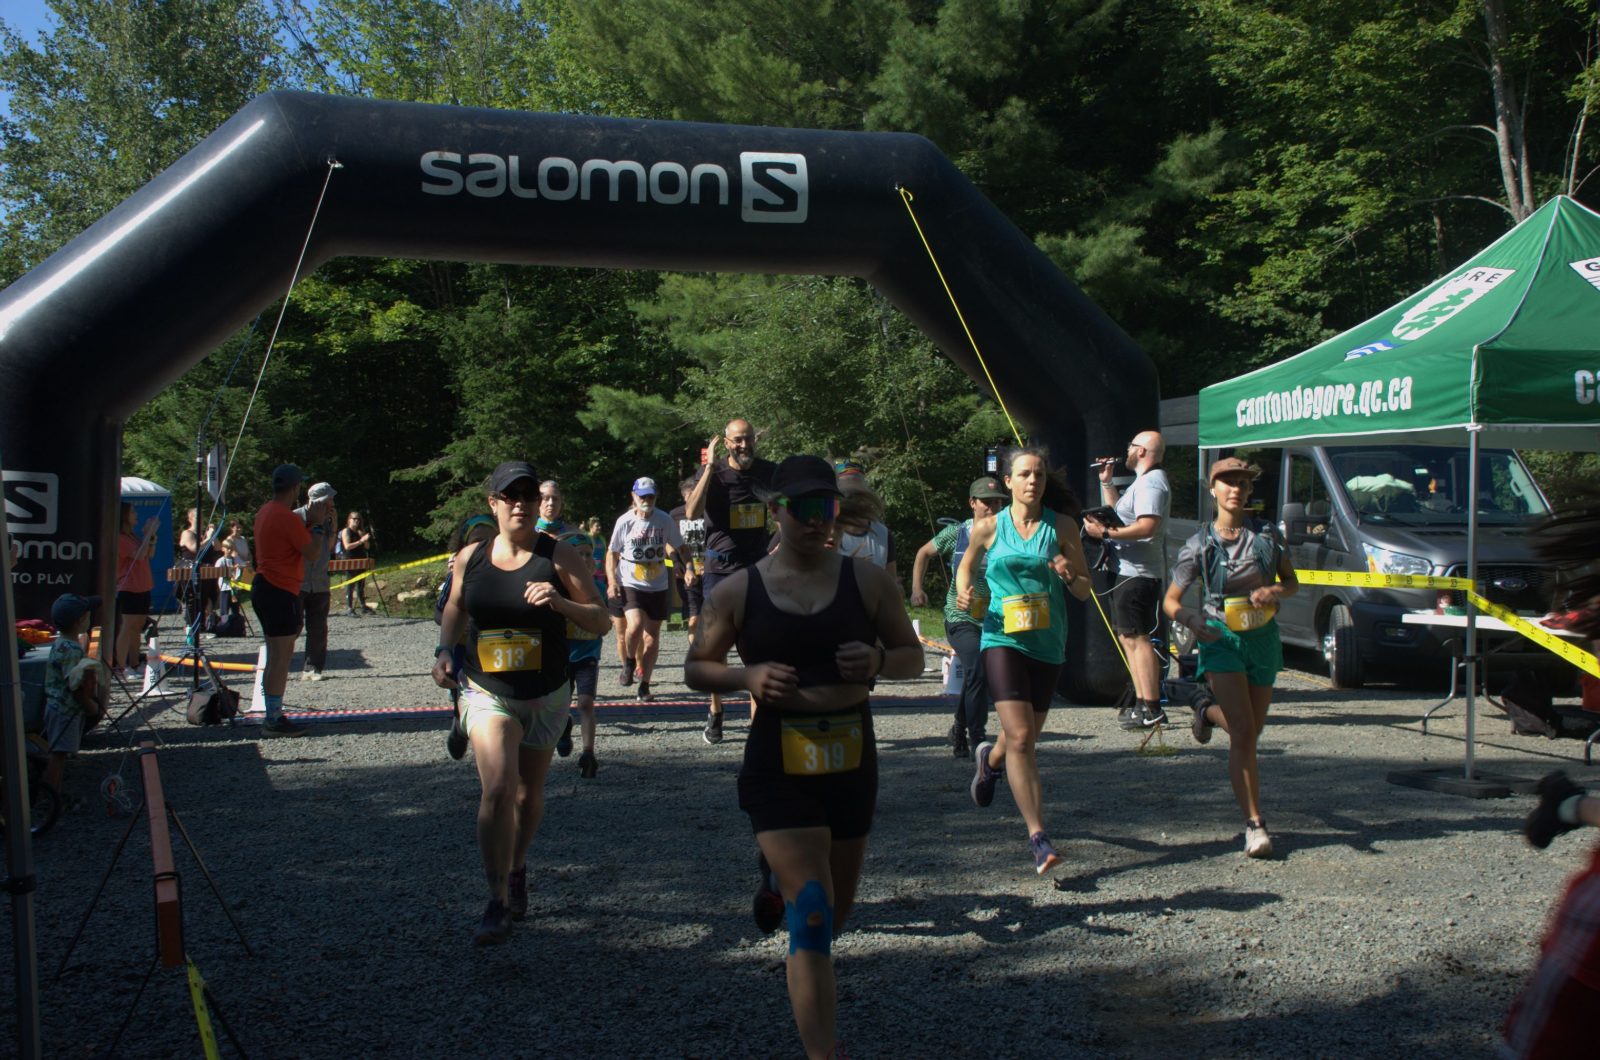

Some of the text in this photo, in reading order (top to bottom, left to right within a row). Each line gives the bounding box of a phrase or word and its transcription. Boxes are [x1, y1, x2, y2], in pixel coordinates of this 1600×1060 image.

[1236, 375, 1414, 428] cantondegore.qc.ca
[11, 572, 74, 585] TO PLAY
[1013, 608, 1041, 629] 327
[1239, 608, 1265, 629] 308
[493, 646, 526, 670] 313
[803, 740, 846, 773] 319
